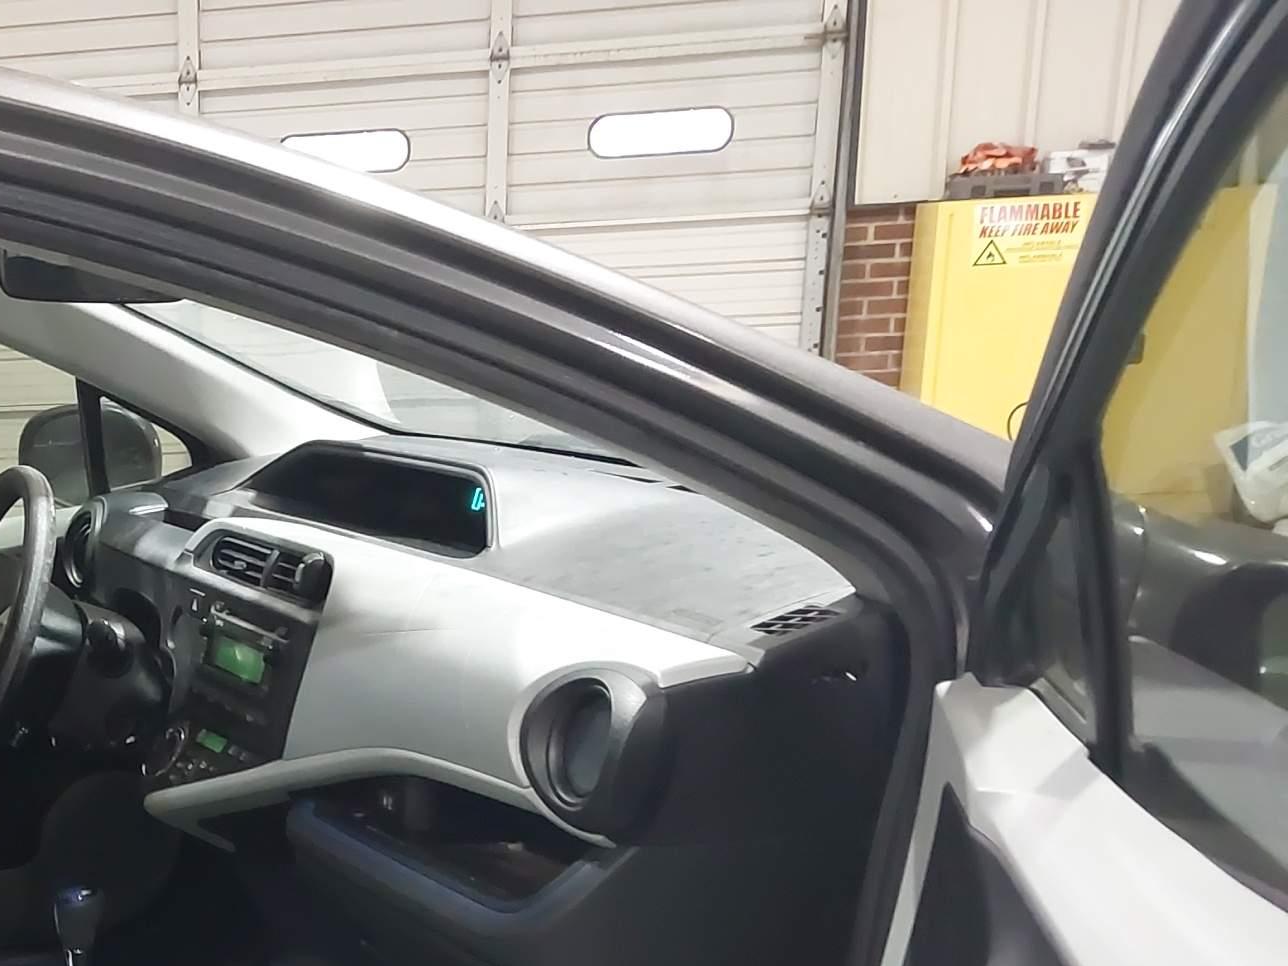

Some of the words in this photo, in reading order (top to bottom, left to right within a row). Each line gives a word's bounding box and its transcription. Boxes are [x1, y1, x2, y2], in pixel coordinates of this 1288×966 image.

[980, 201, 1081, 224] FLAMMABLE
[979, 224, 1011, 238] KEEP
[1011, 223, 1040, 236] FIRE
[1040, 220, 1078, 235] AWAY
